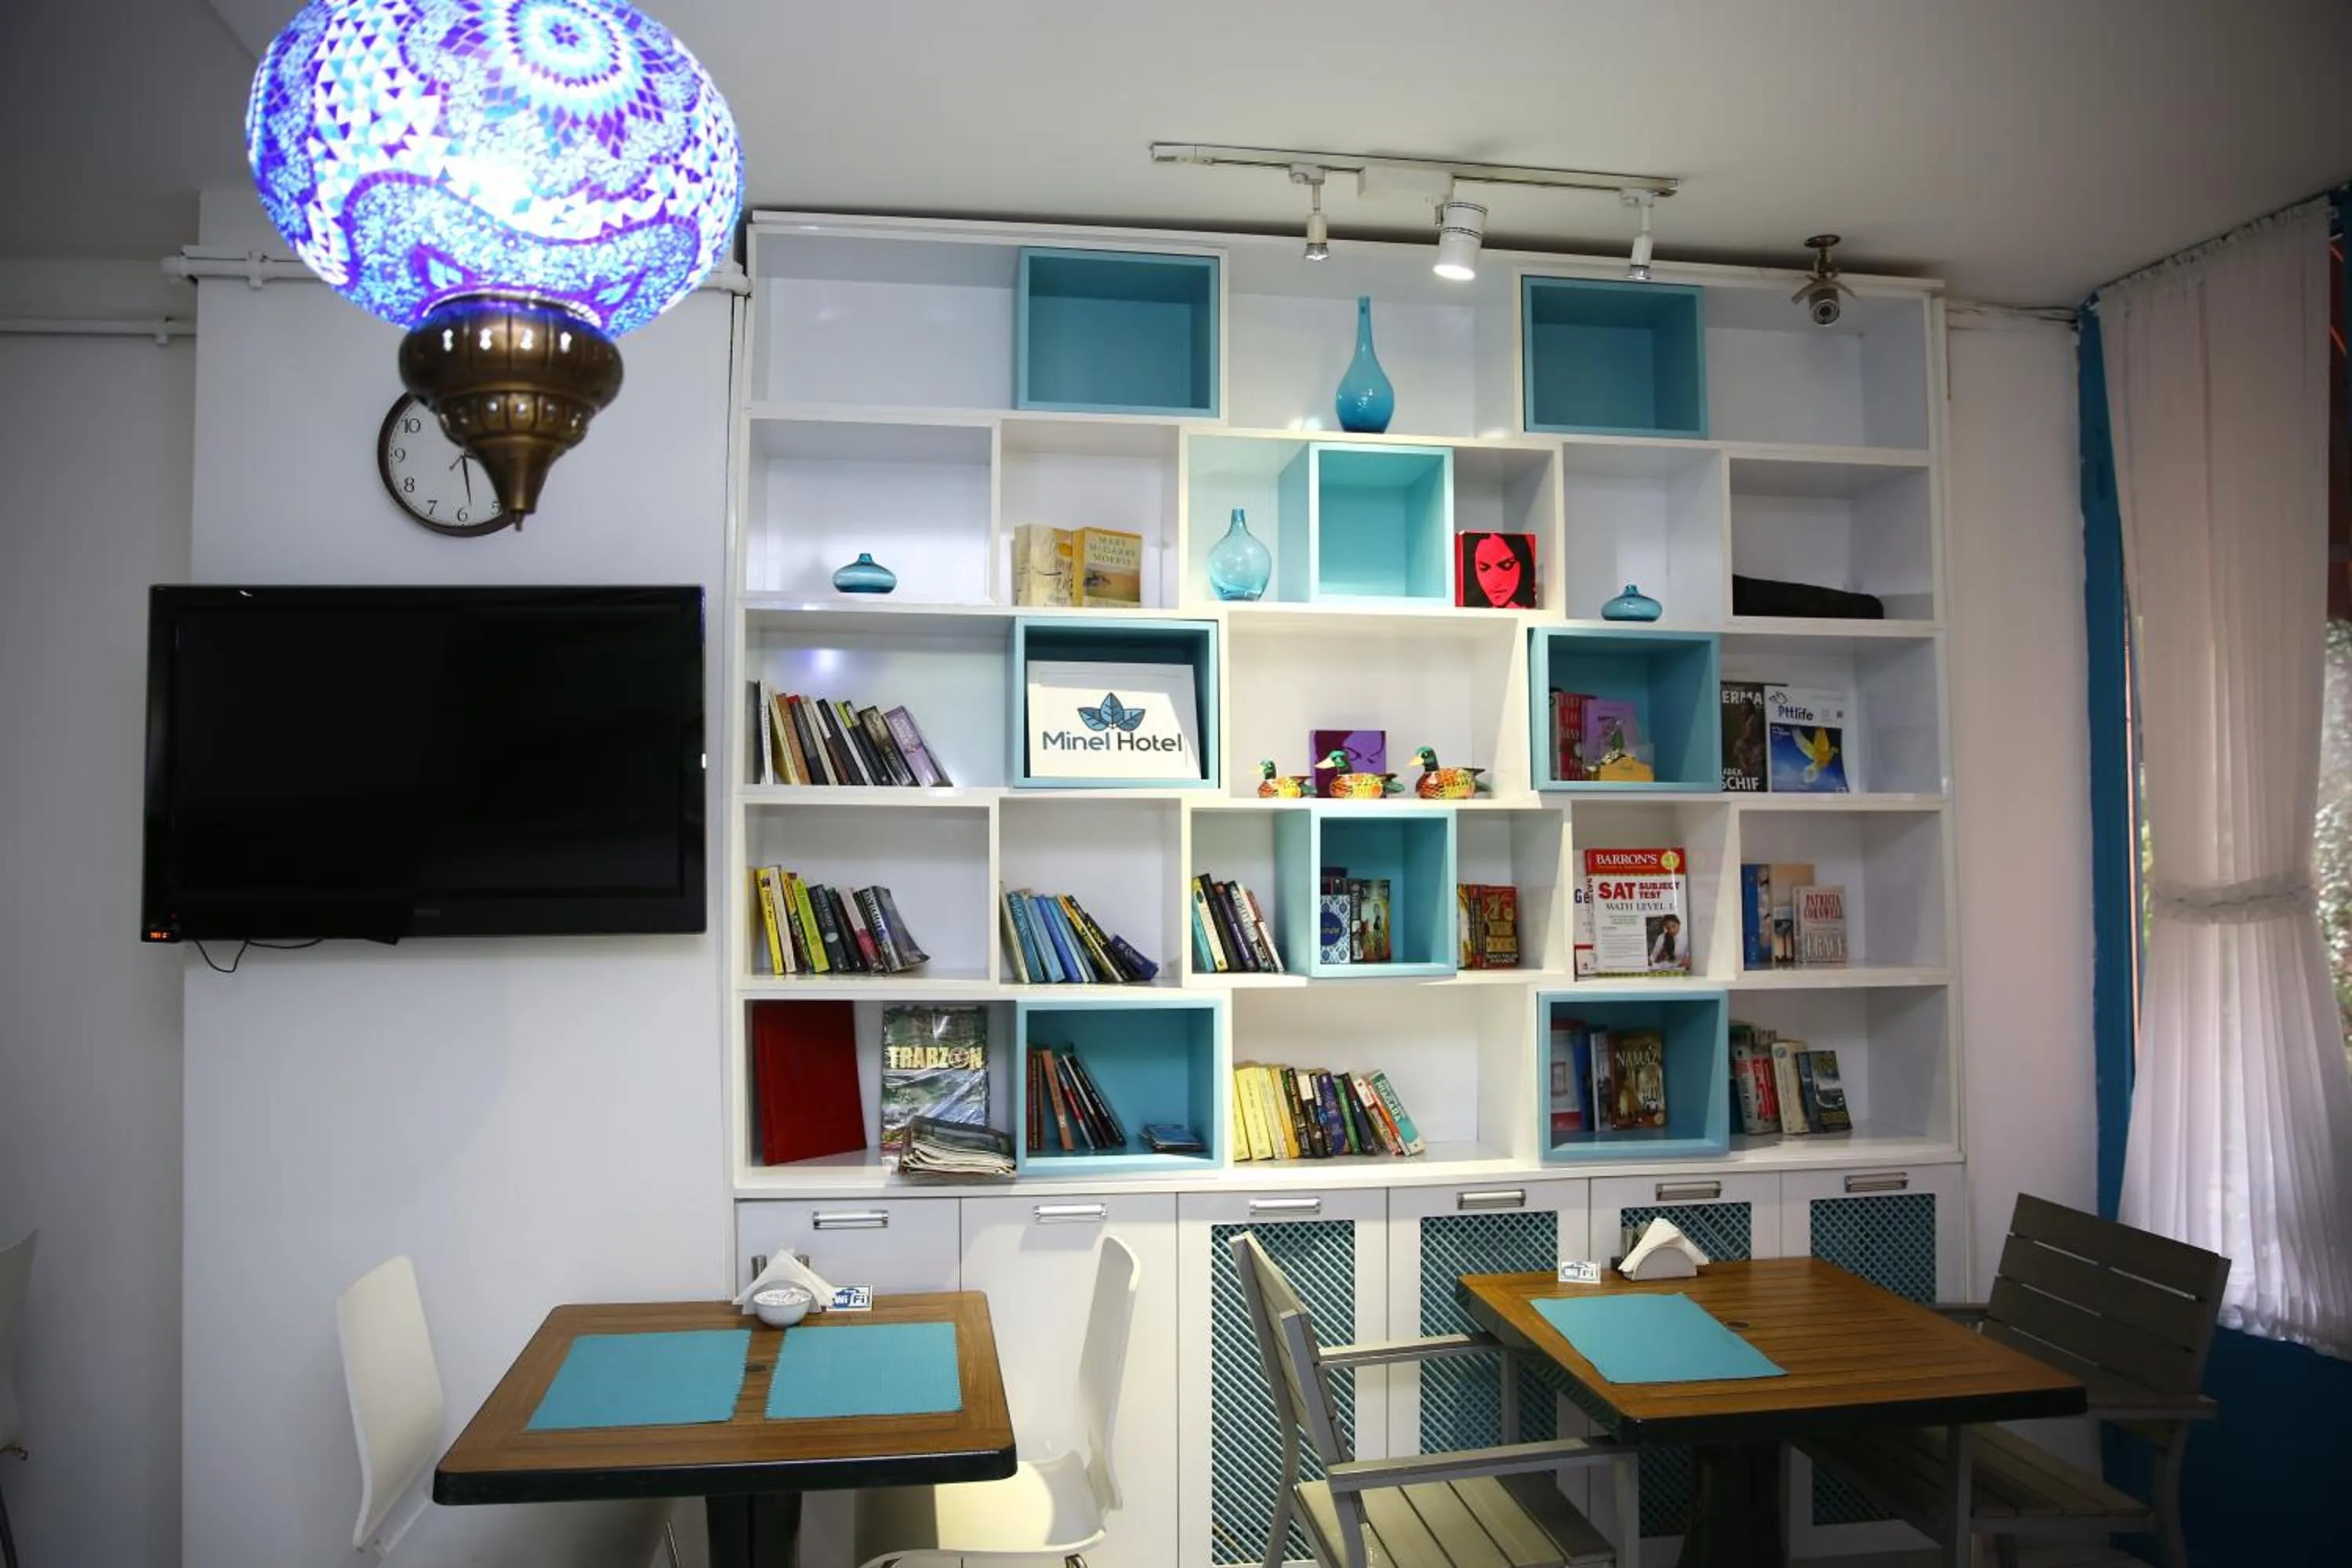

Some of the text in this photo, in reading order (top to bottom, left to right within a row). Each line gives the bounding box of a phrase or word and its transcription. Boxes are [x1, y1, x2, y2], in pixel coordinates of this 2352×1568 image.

[404, 418, 421, 434] 10
[394, 448, 406, 463] 9
[404, 477, 415, 492] 8
[427, 500, 437, 516] 7
[457, 507, 468, 522] 6
[492, 501, 502, 515] 5
[1042, 731, 1182, 752] Minel Hotel
[1596, 854, 1657, 865] BARRON'S
[1599, 882, 1680, 900] SAT SUBJECT
[1639, 891, 1661, 899] TEST
[1636, 902, 1666, 911] LEVEL
